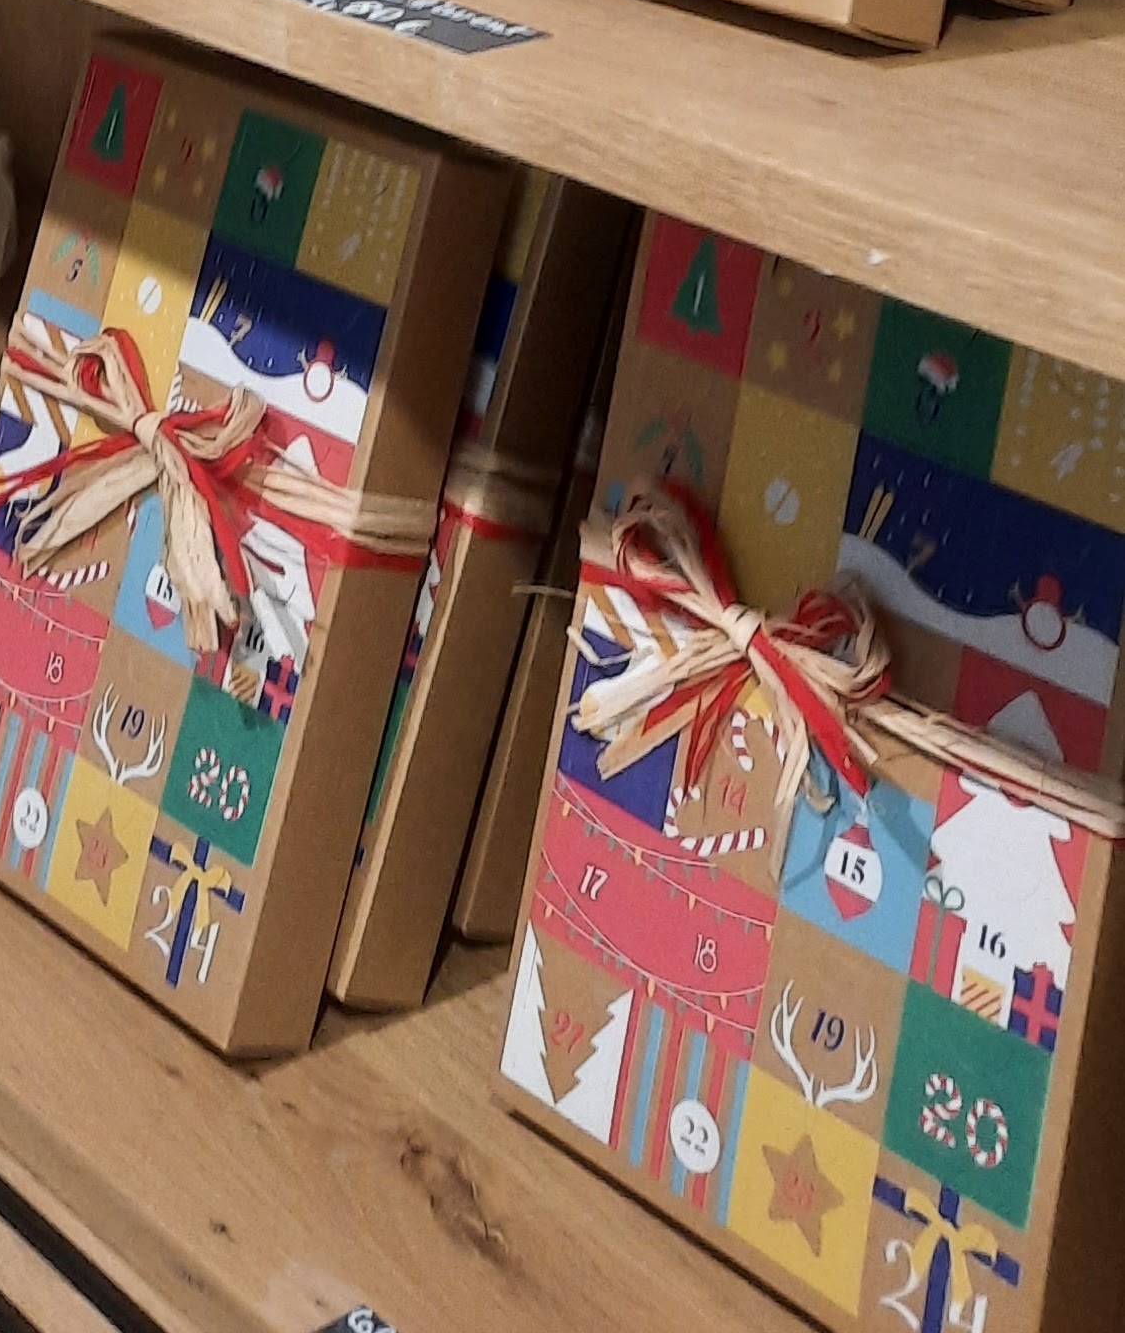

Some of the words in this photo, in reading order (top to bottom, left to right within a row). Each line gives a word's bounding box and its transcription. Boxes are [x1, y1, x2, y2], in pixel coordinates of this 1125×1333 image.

[45, 650, 65, 684] 18
[120, 705, 145, 739] 19
[188, 746, 251, 822] 20
[721, 774, 748, 816] 14
[579, 863, 610, 901] 17
[840, 849, 868, 885] 15
[692, 932, 718, 973] 18
[977, 923, 1007, 961] 16
[550, 1010, 586, 1055] 21
[810, 1007, 847, 1052] 19
[919, 1072, 1009, 1168] 20
